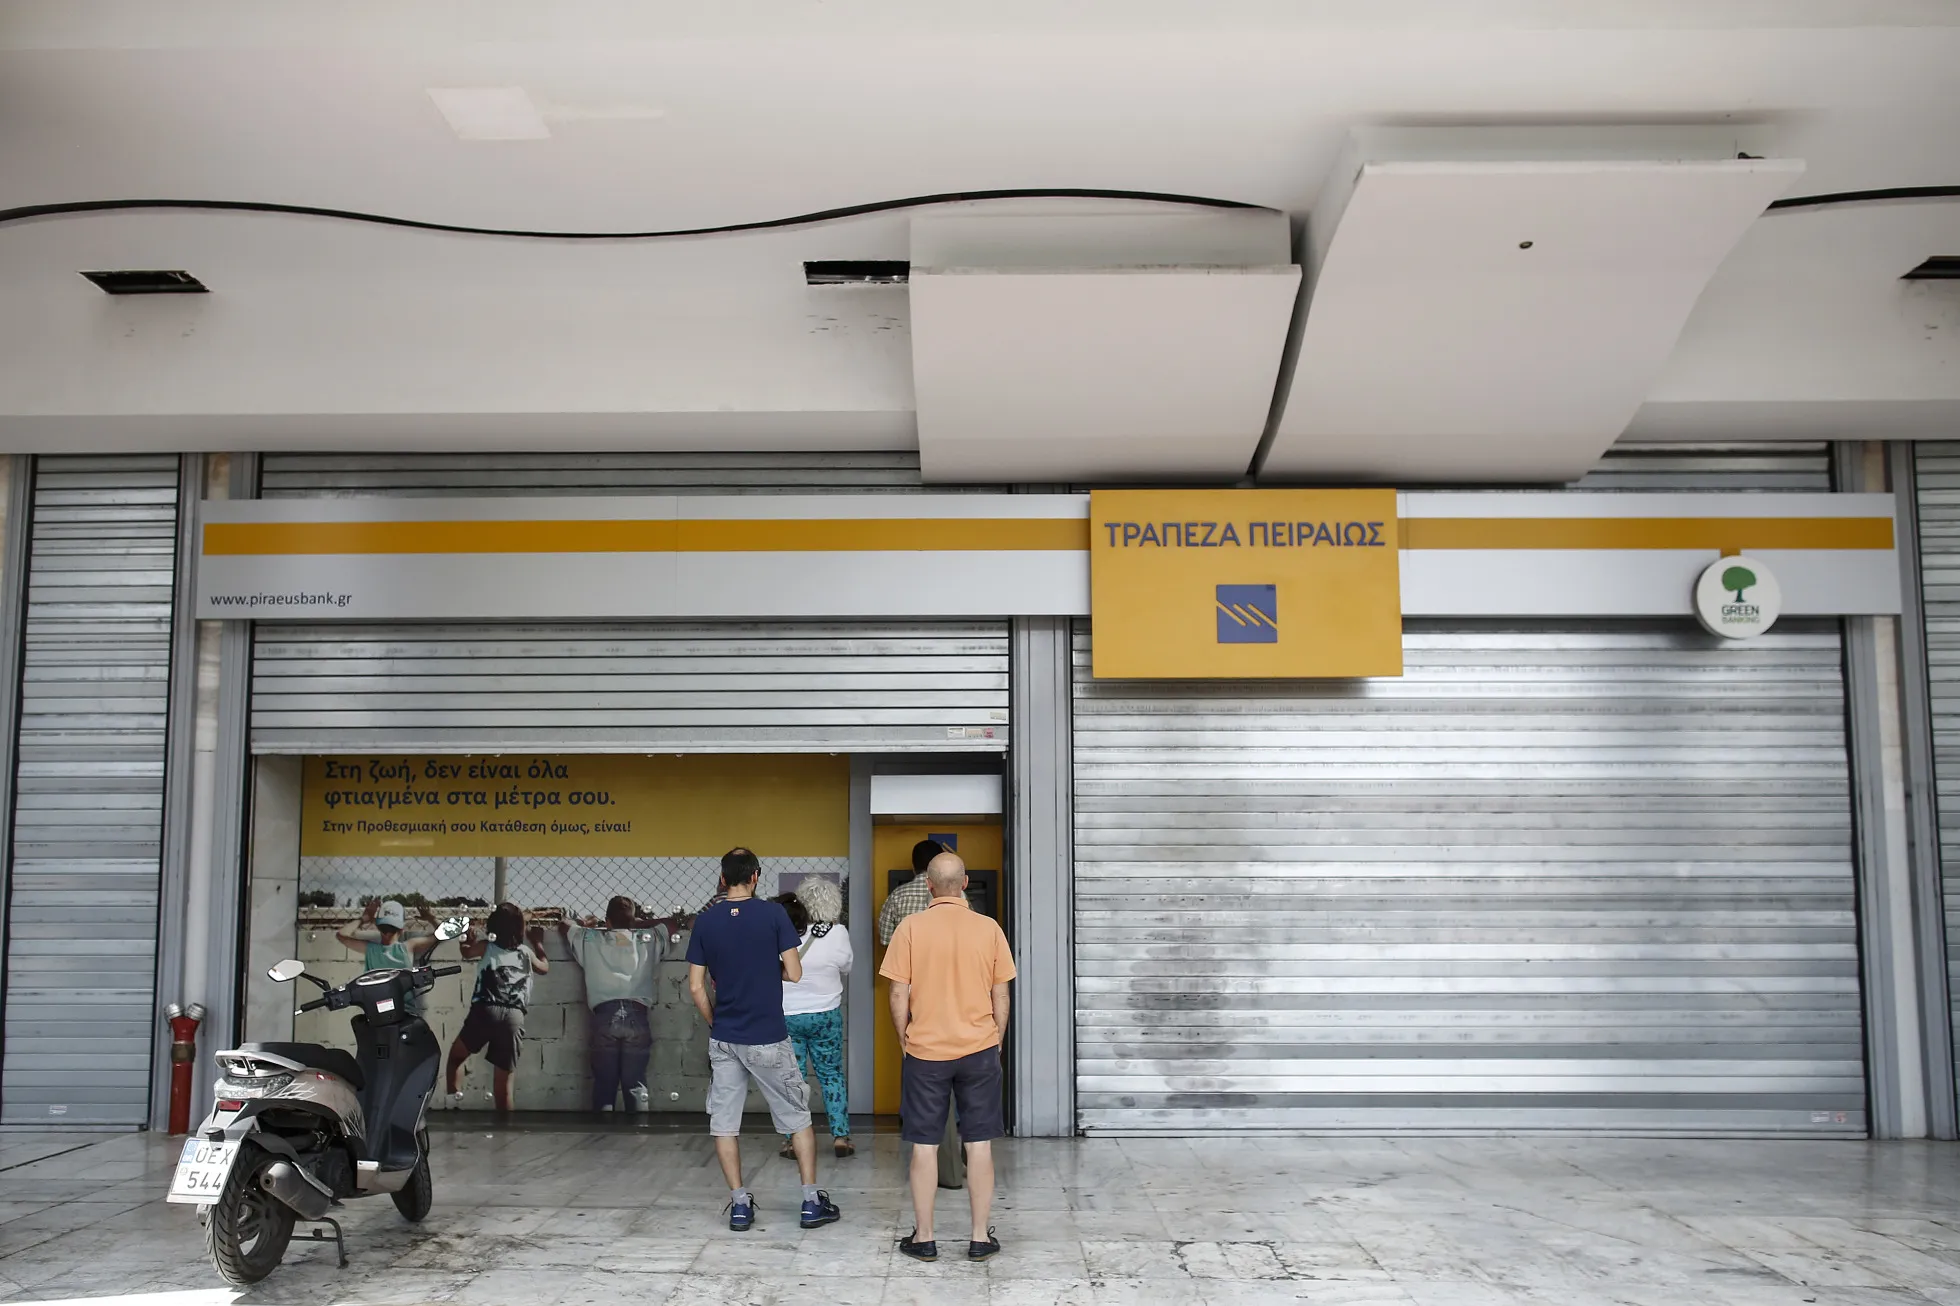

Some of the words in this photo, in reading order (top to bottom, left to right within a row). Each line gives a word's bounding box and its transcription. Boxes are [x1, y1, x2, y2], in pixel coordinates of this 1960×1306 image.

[1104, 522, 1241, 548] ΤΡΑΠΕΖΑ
[1249, 522, 1386, 548] ΠΕΙΡΑΙΩΣ
[210, 591, 353, 609] www.piraeusbank.gr
[1721, 604, 1760, 616] GREEN
[325, 761, 361, 782] Στη
[369, 760, 416, 783] ζωή,
[424, 760, 462, 779] δεν
[469, 760, 521, 779] είναι
[528, 760, 569, 779] όλα
[324, 785, 440, 809] φτιαγμένα
[447, 791, 488, 806] στα
[495, 785, 561, 809] μέτρα
[569, 791, 616, 806] σου.
[323, 821, 352, 834] Στην
[357, 820, 447, 835] Προθεσμιακή
[451, 823, 476, 833] σου
[480, 820, 546, 835] Κατάθεση
[551, 820, 590, 835] όμως,
[595, 820, 631, 833] είναι!
[187, 1170, 222, 1191] 544
